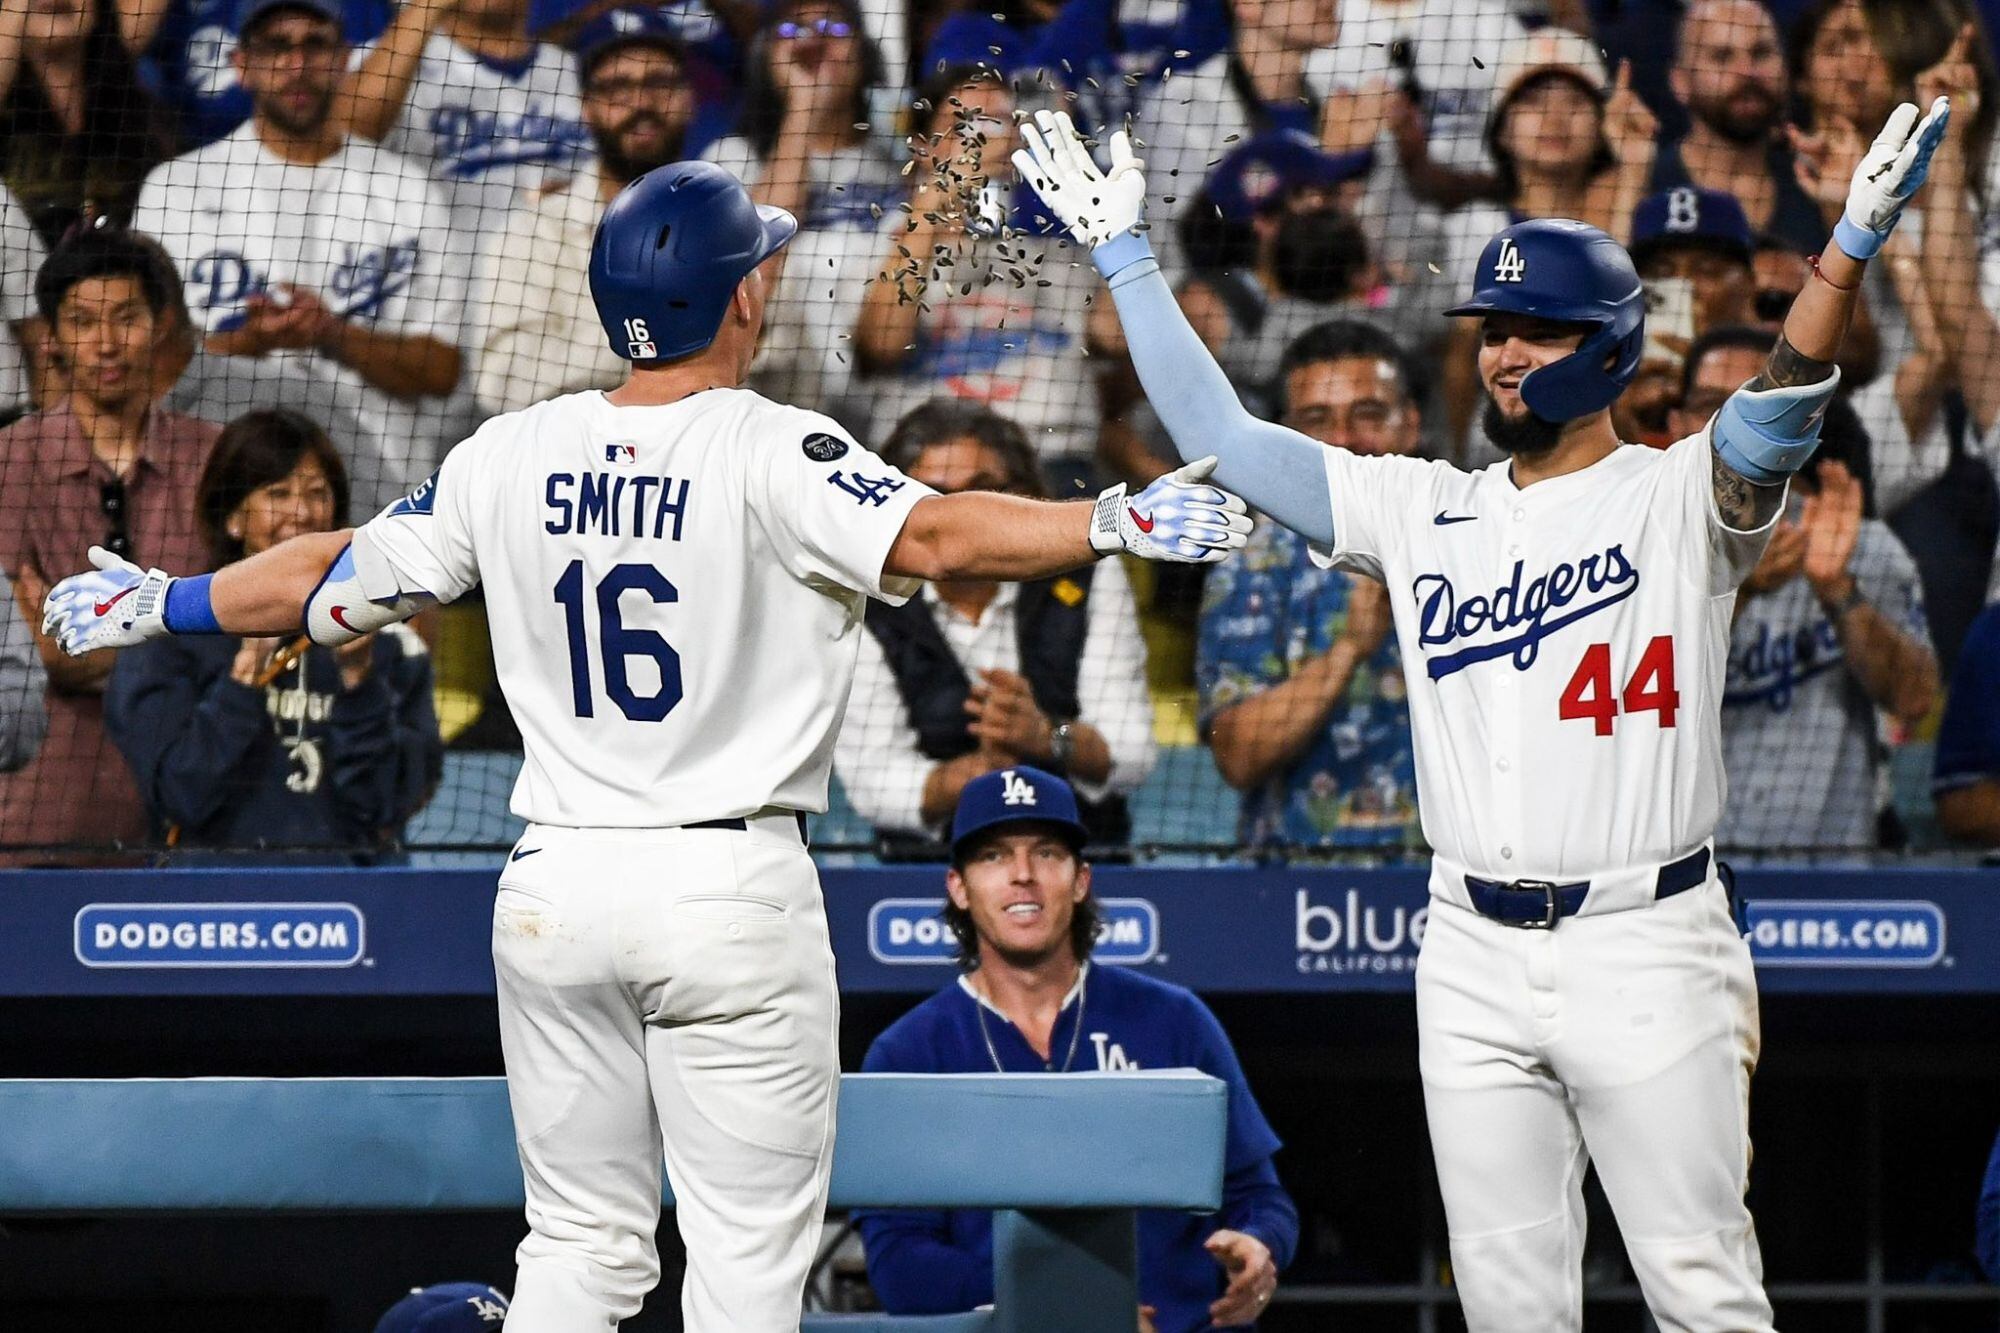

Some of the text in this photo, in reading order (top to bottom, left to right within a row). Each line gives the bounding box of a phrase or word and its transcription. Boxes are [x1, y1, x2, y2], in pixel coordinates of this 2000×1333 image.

[1665, 188, 1698, 233] B
[1495, 238, 1525, 282] LA
[623, 318, 649, 341] 16
[545, 472, 691, 542] SMITH
[827, 470, 906, 507] LA
[1413, 544, 1639, 684] Dodgers
[553, 559, 683, 722] 16
[1559, 635, 1680, 736] 44
[1001, 770, 1036, 806] LA
[94, 921, 348, 949] DODGERS.COM
[1744, 918, 1930, 949] GERS.COM
[1297, 955, 1417, 973] CALIFORN
[467, 1296, 506, 1321] LA
